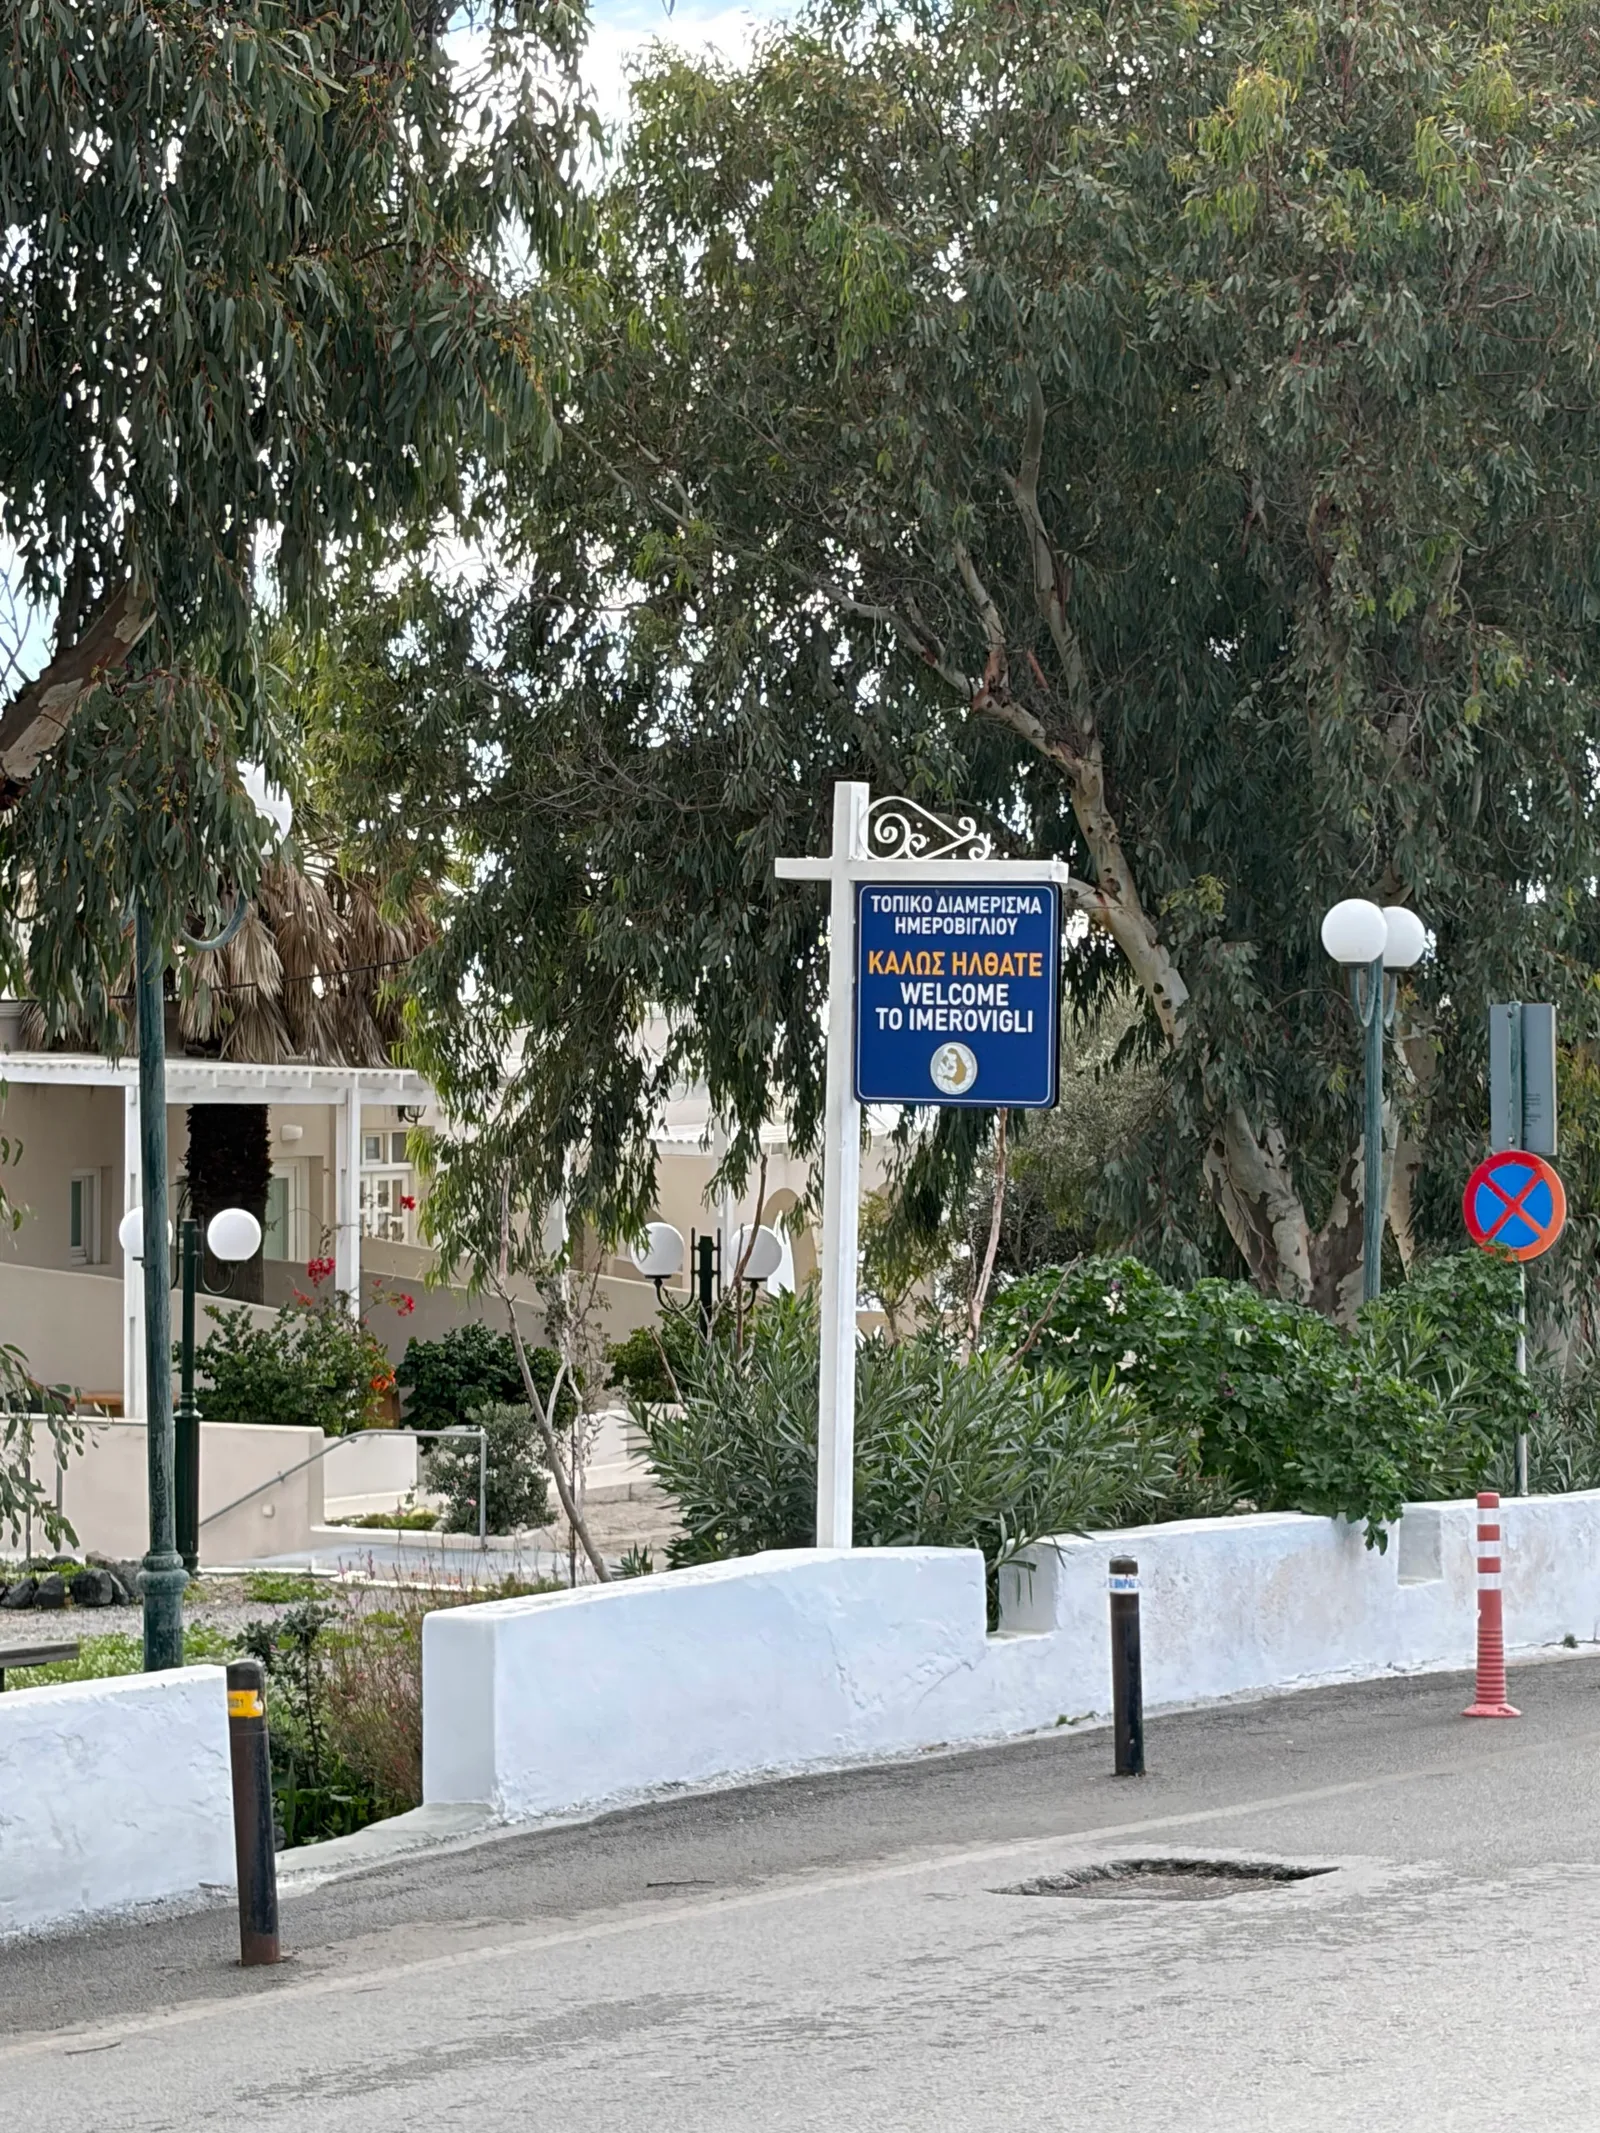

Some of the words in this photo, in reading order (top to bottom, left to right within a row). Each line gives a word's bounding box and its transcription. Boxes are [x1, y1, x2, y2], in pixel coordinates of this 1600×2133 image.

[871, 896, 932, 913] ΤΟΠΙΚΟ
[937, 896, 1042, 914] ΔΙΑΜΕΡΙΣΜΑ
[895, 917, 1018, 935] ΗΜΕΡΟΒΙΓΛΙΟΥ
[869, 951, 945, 975] ΚΑΛΩΣ
[952, 952, 1043, 977] ΗΛΘΑΤΕ
[900, 982, 1009, 1006] WELCOME
[876, 1007, 902, 1030] TO
[909, 1008, 1033, 1032] IMEROVIGLI
